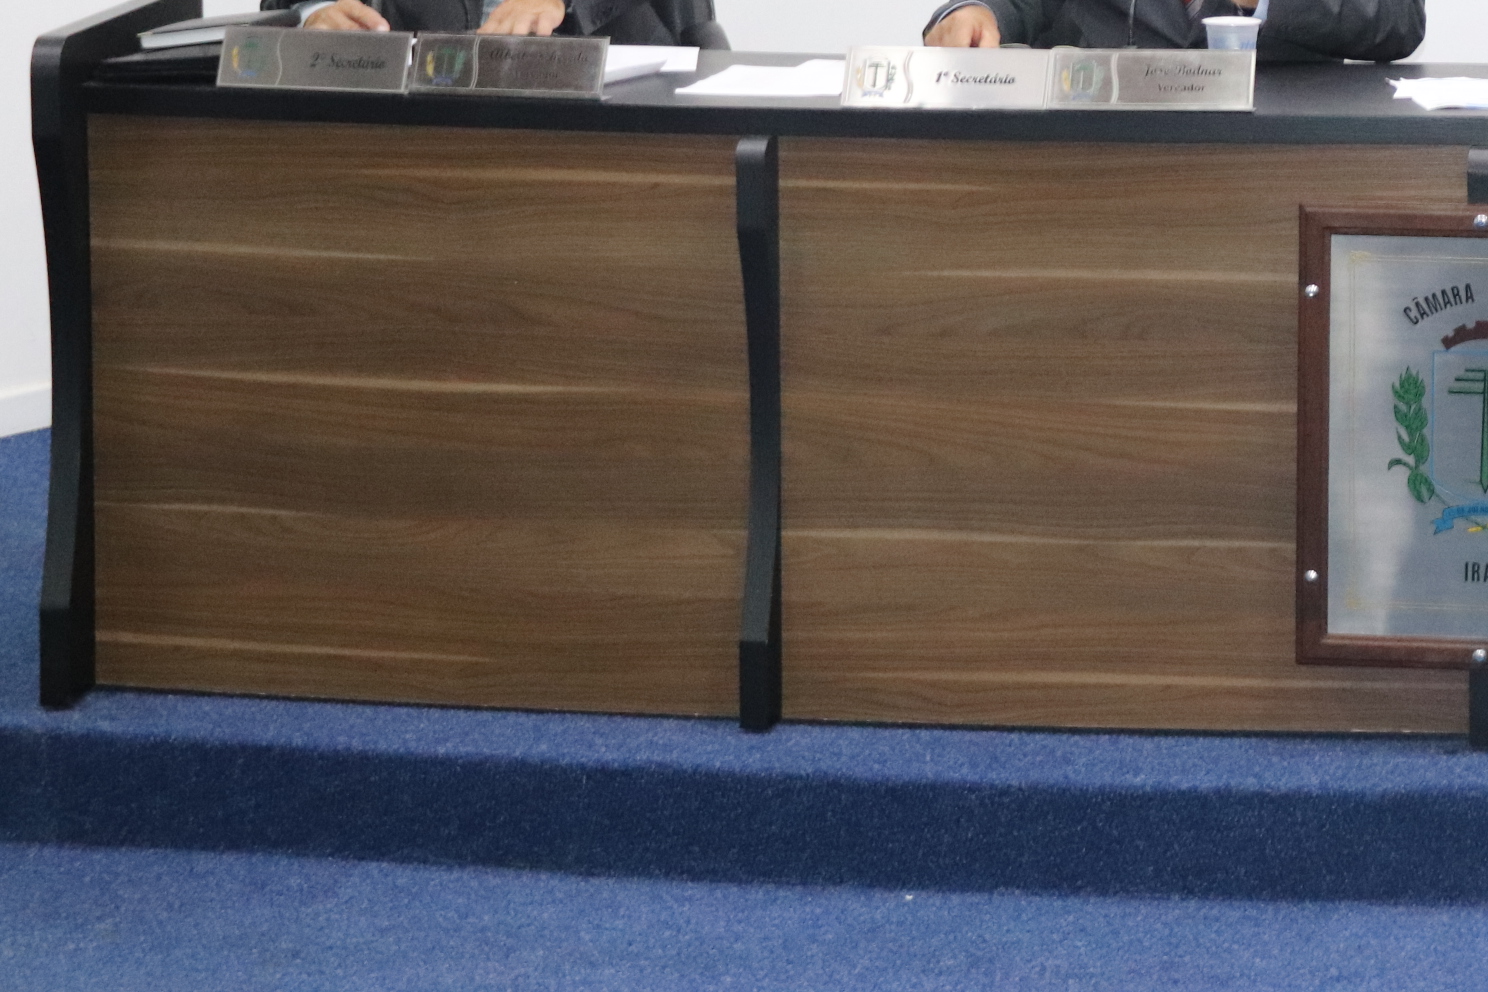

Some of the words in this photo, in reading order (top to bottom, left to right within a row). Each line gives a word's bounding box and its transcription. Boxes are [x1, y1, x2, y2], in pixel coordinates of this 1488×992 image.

[951, 69, 1016, 85] Secretário
[1158, 83, 1205, 92] Vereador
[1403, 282, 1475, 326] CÂMARA
